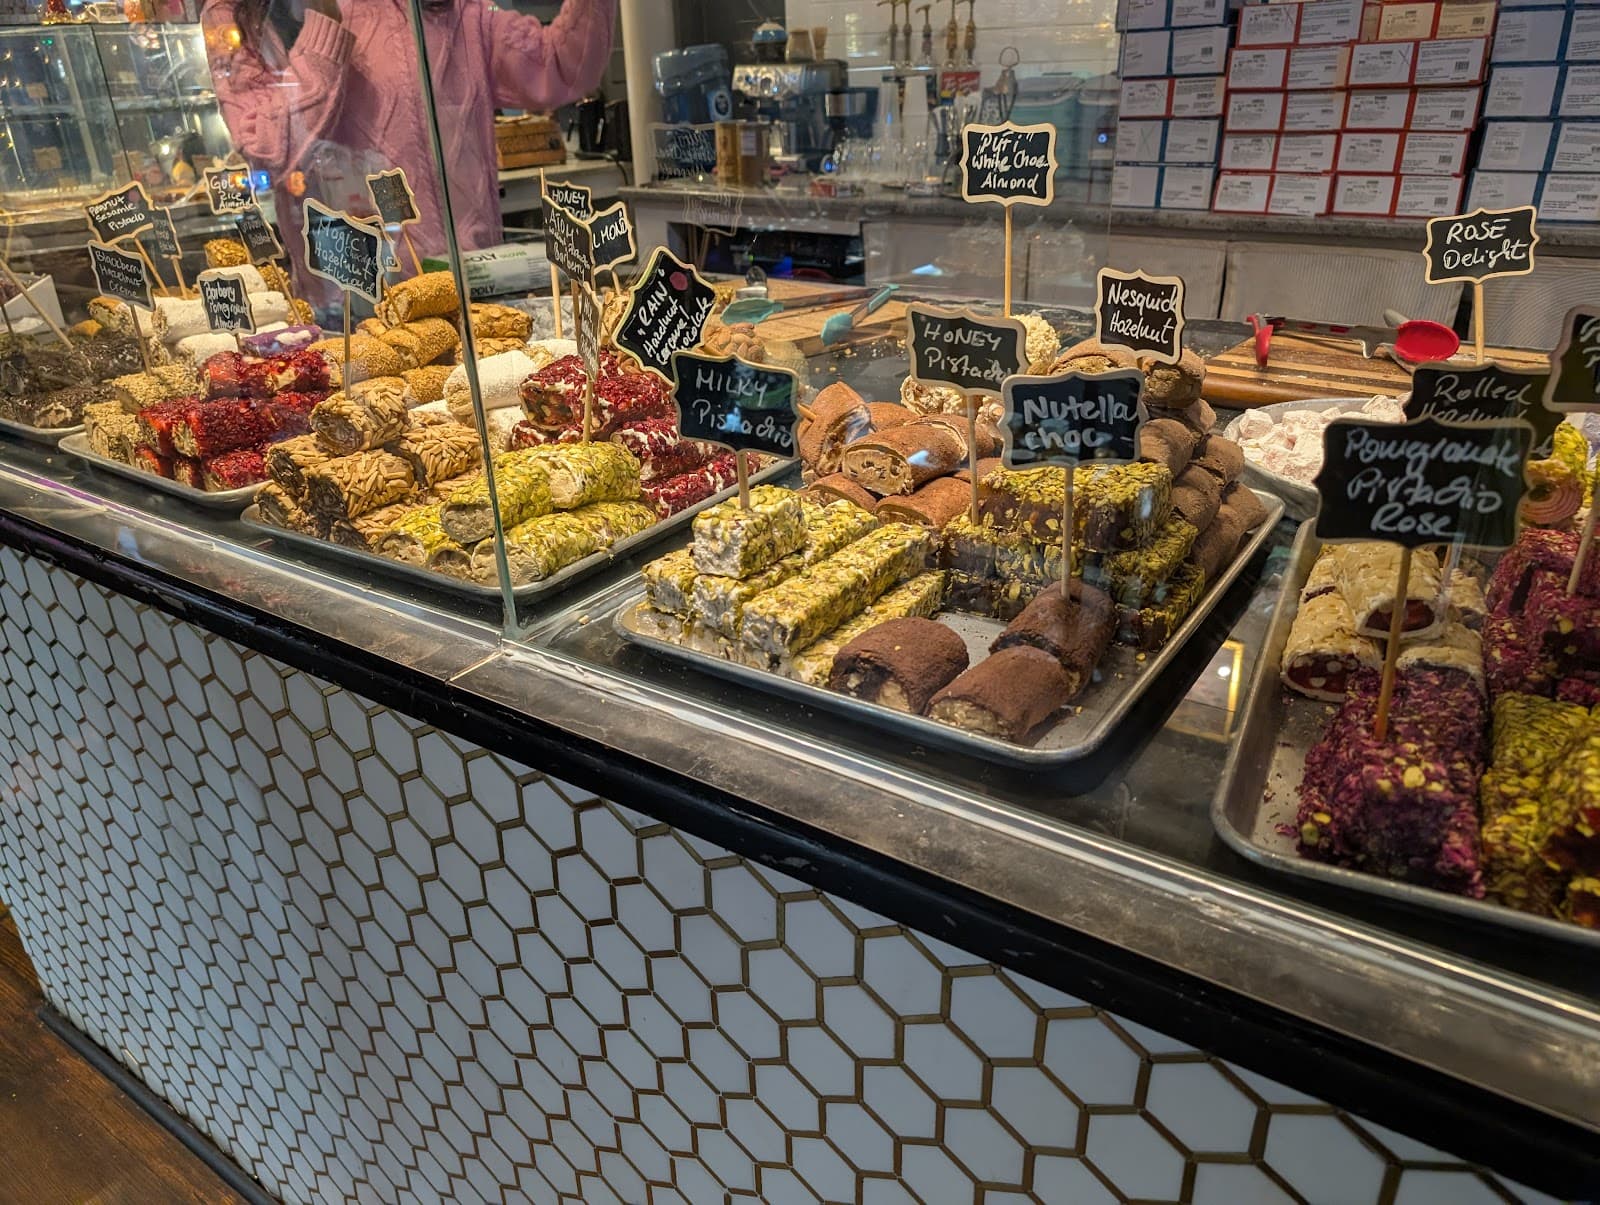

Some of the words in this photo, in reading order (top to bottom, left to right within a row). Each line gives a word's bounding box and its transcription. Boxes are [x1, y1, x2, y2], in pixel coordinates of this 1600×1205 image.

[552, 189, 585, 209] HONEY
[980, 172, 1039, 195] Almond
[89, 196, 125, 217] Peanut
[592, 211, 627, 250] LMOND
[1446, 218, 1511, 245] ROSE
[1443, 238, 1529, 269] Delight
[643, 296, 679, 358] Hazelnut
[1110, 310, 1174, 344] Hazelnut
[695, 368, 768, 407] MILKY
[1434, 374, 1532, 405] Rolled
[692, 399, 793, 447] Pistachio
[1023, 394, 1139, 425] Nutella
[1371, 502, 1461, 536] Rose
